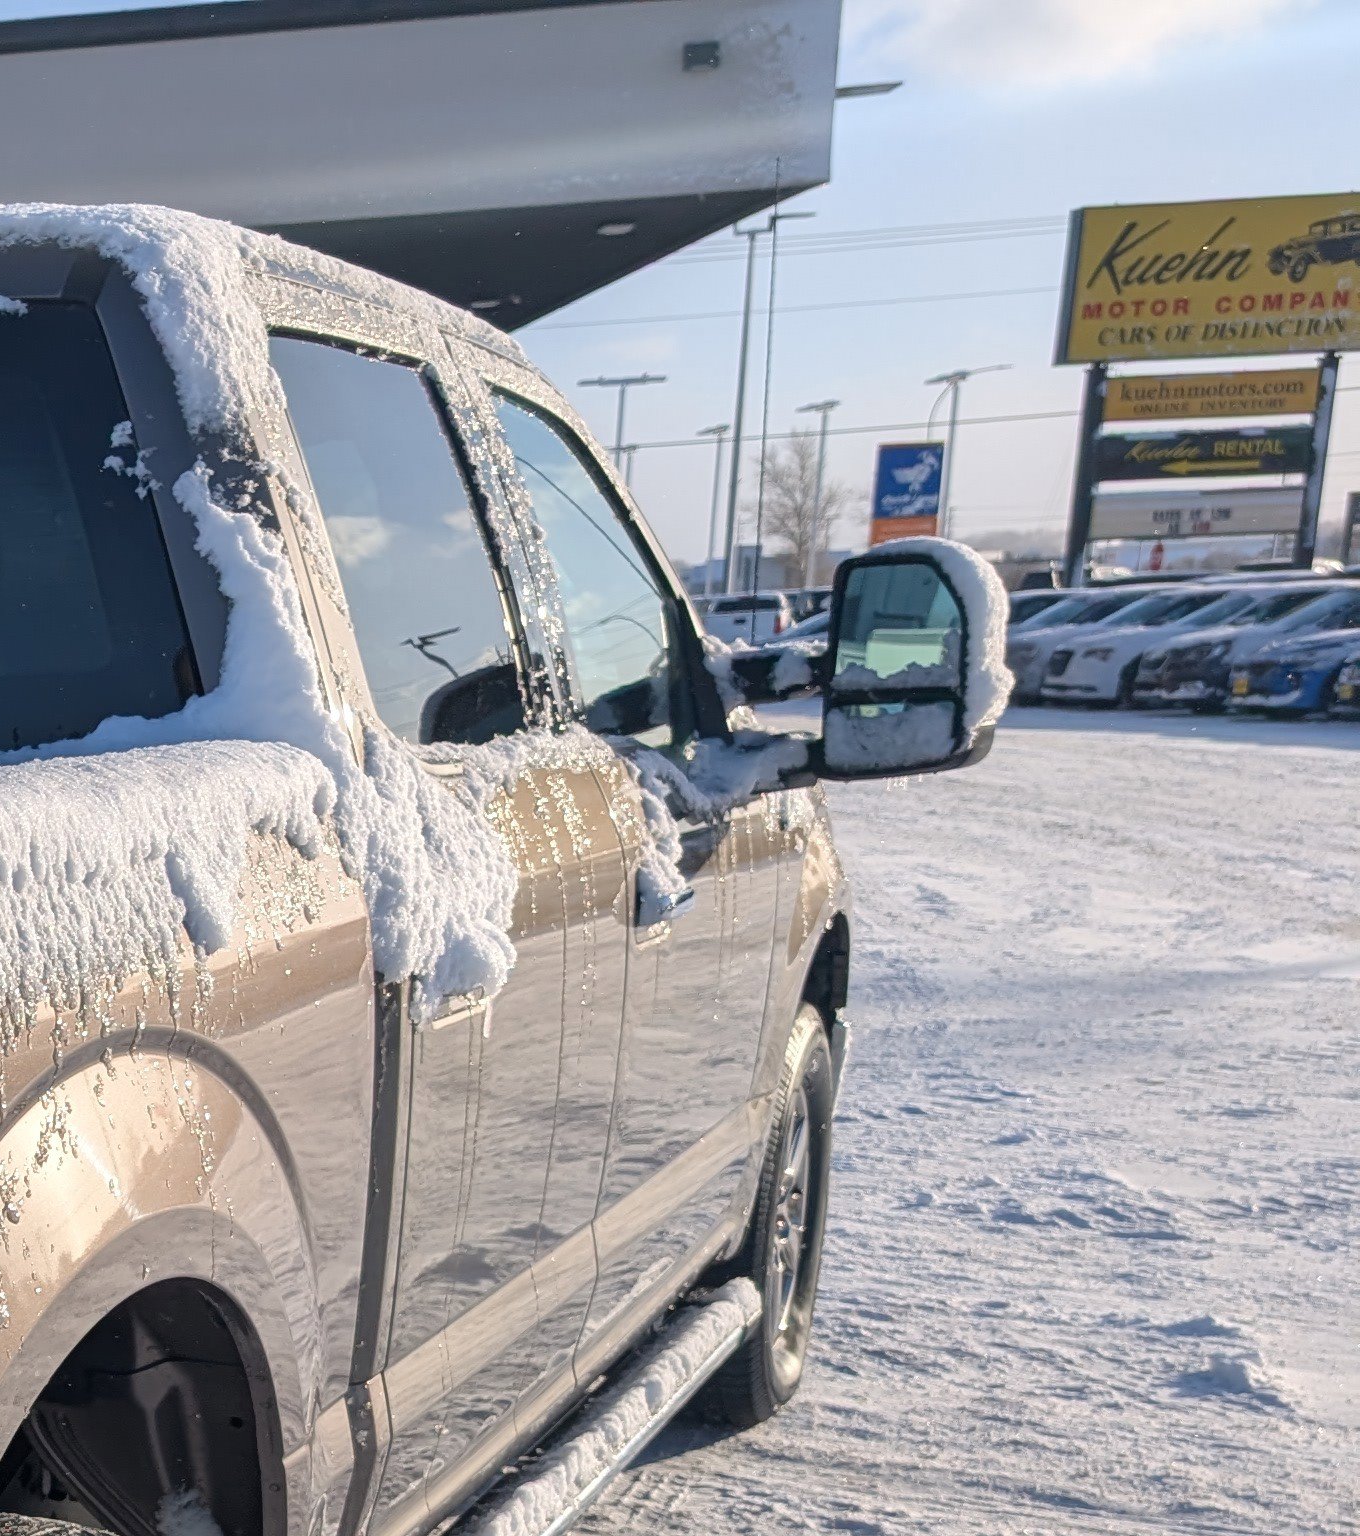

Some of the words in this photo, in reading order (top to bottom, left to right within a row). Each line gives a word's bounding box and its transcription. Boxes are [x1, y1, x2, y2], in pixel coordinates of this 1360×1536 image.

[1086, 216, 1252, 295] Kuehn
[1082, 299, 1189, 319] MOTOR
[1215, 290, 1360, 314] COMPAN
[1098, 325, 1158, 346] CARS
[1165, 323, 1194, 342] OF
[1120, 379, 1305, 401] kuehnmotors.com
[1214, 438, 1285, 456] RENTAL
